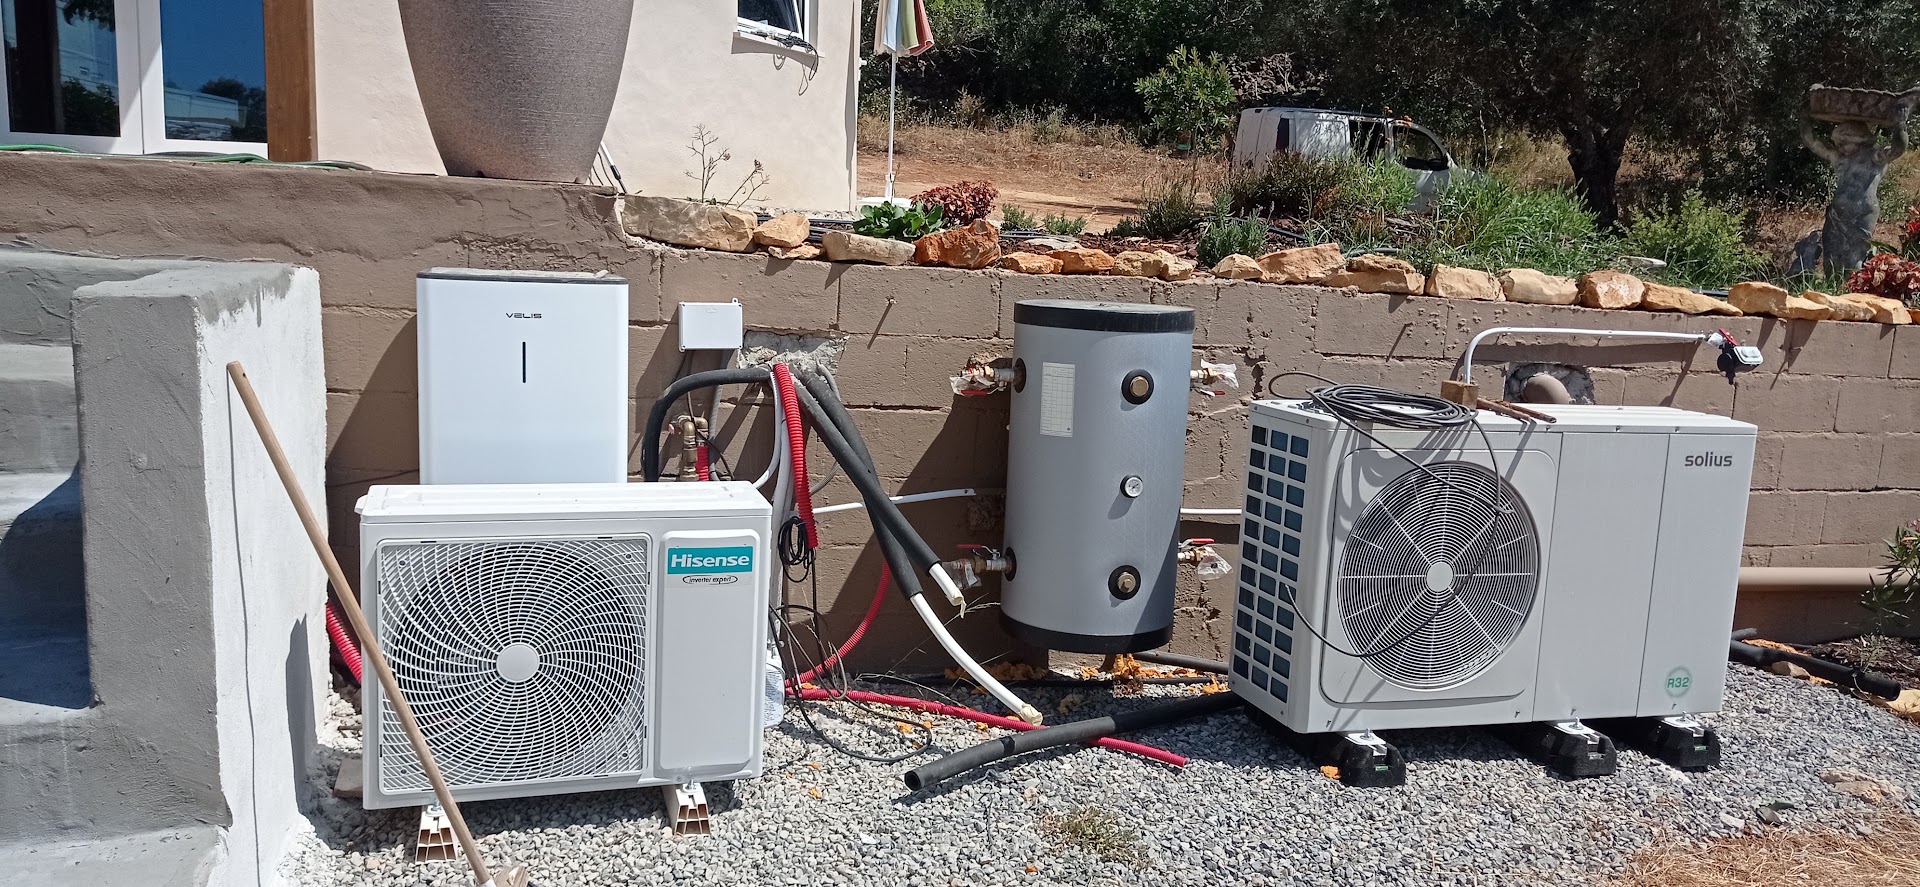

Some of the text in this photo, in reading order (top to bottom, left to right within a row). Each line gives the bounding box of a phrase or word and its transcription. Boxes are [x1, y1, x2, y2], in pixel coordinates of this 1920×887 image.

[1684, 451, 1733, 467] solius
[671, 554, 750, 568] Hisense
[712, 576, 732, 585] expert
[1667, 676, 1690, 688] R32
